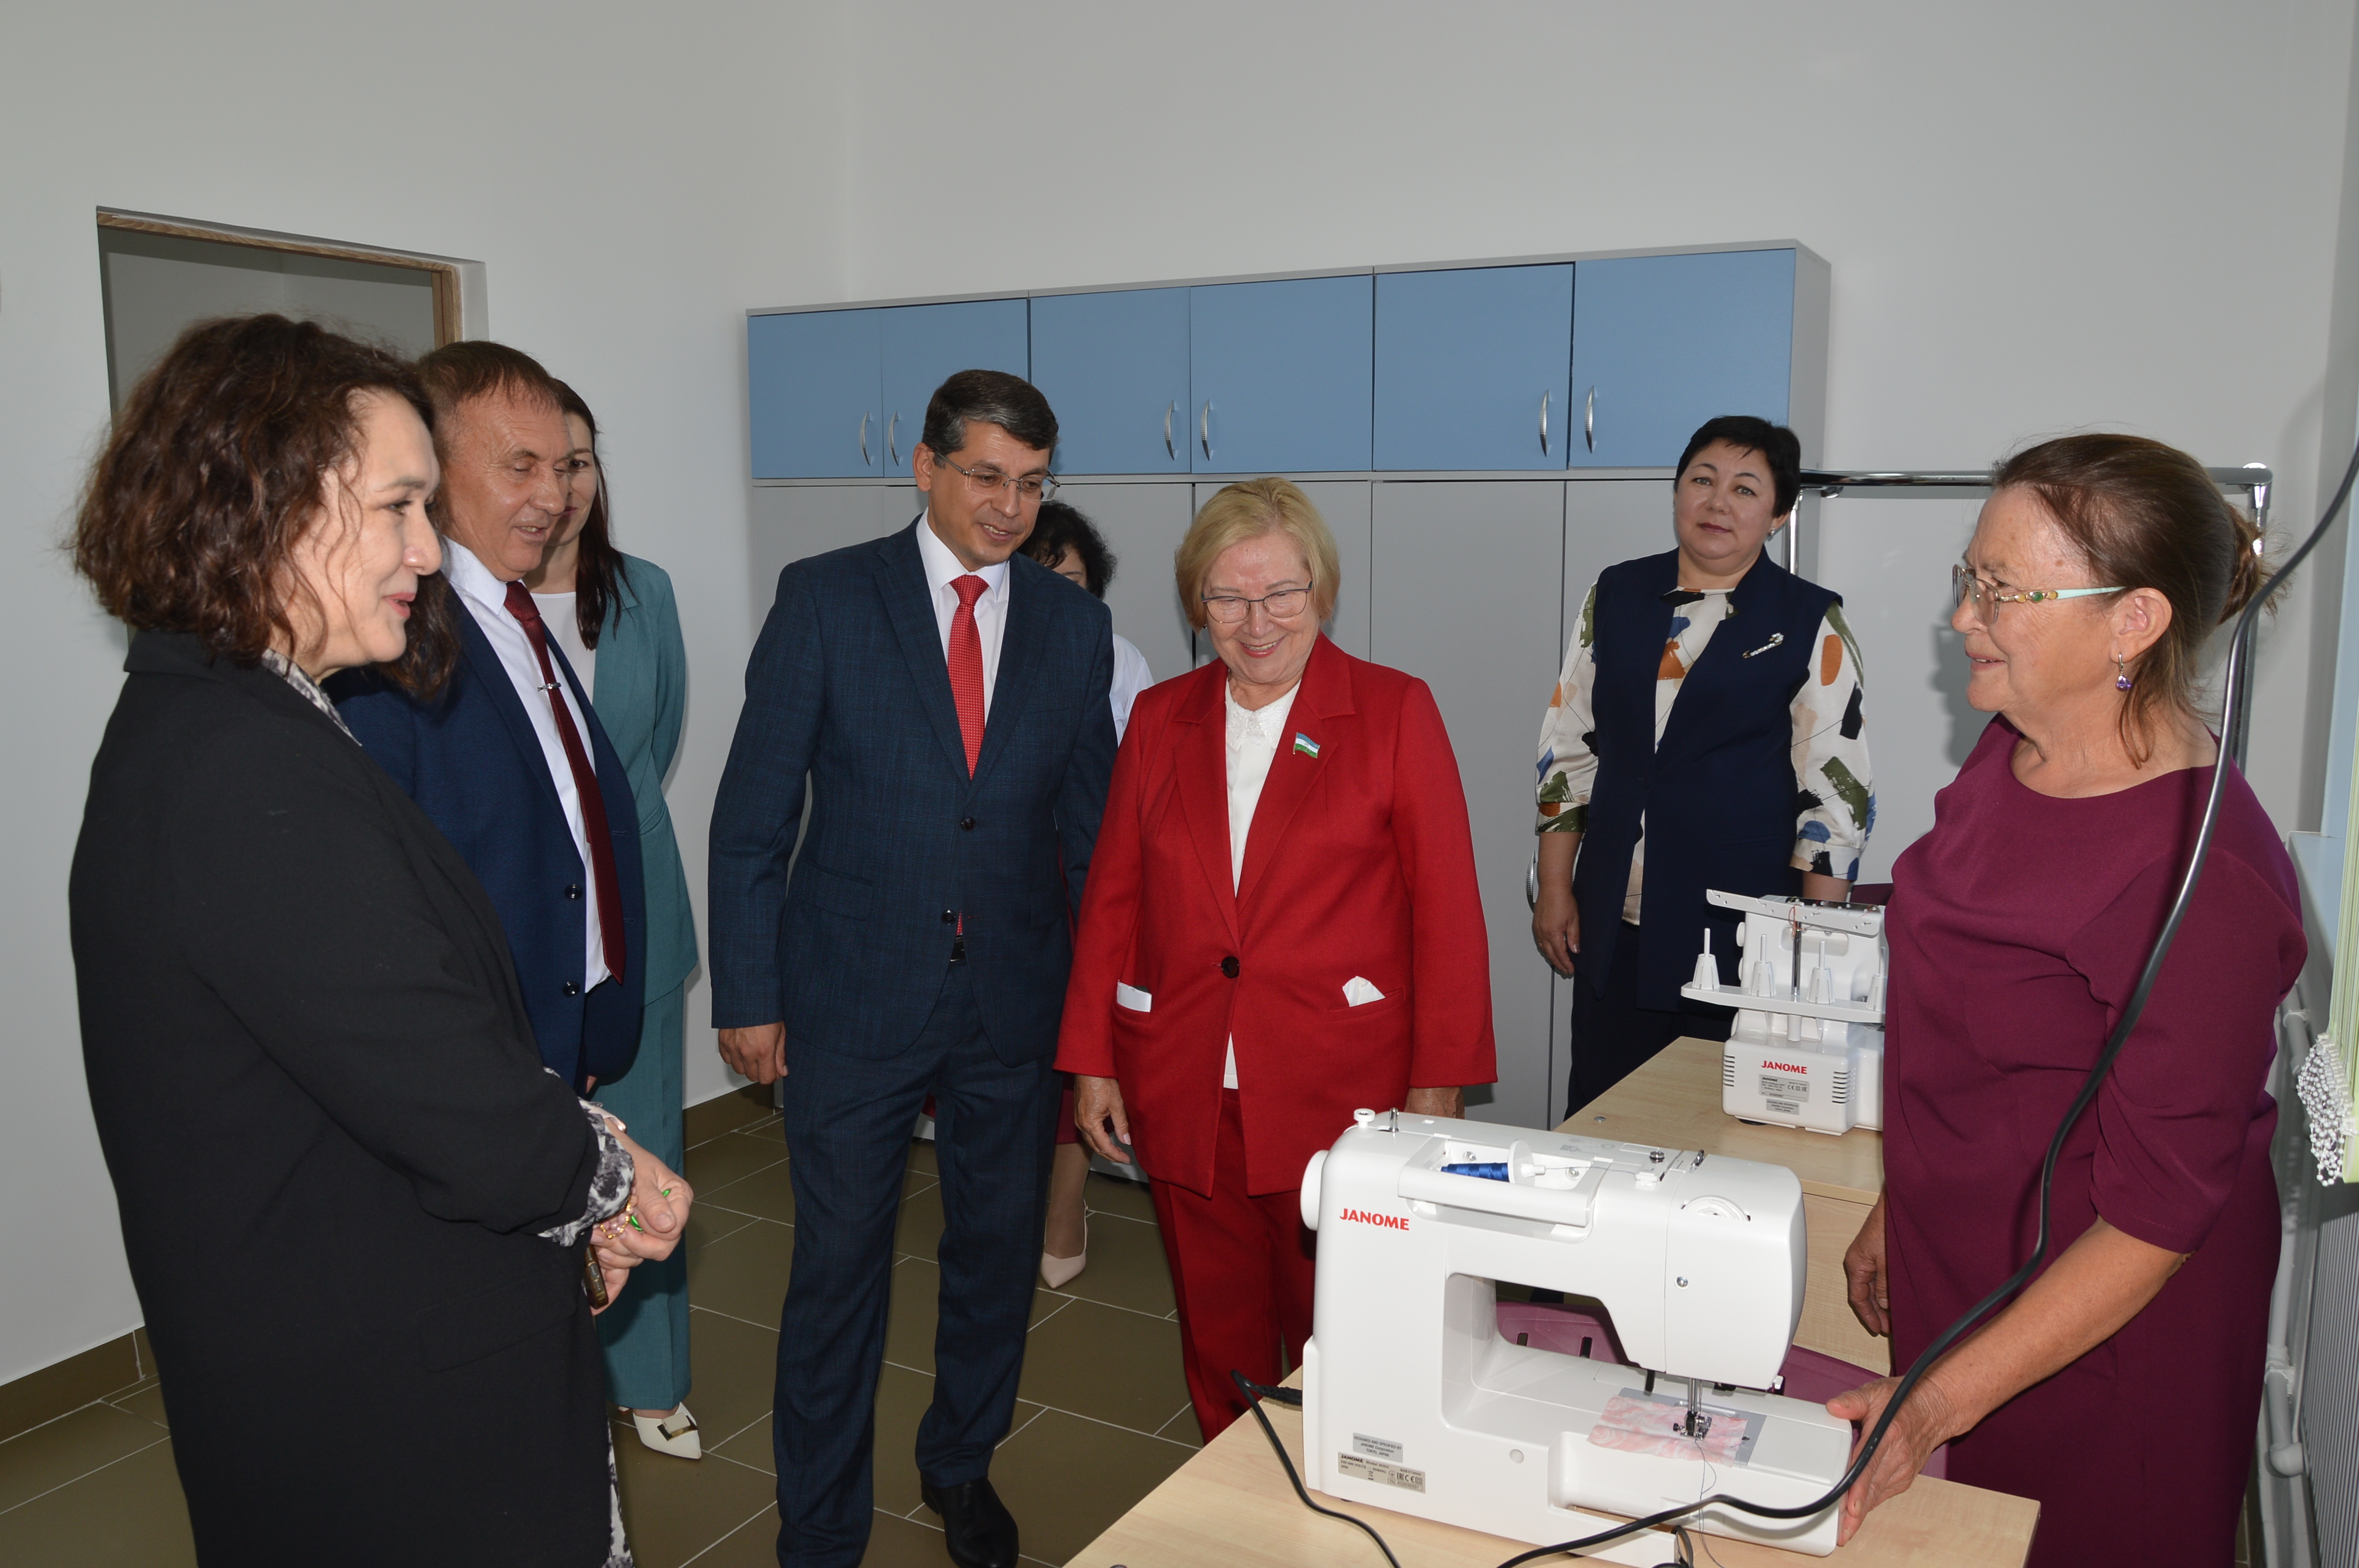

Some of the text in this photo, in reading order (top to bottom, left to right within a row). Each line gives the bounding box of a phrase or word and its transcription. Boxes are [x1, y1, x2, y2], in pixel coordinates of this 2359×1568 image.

[1761, 1060, 1807, 1074] JANOME
[1339, 1208, 1410, 1231] JANOME
[1375, 1445, 1394, 1454] Corporation
[1341, 1454, 1364, 1463] JANOME
